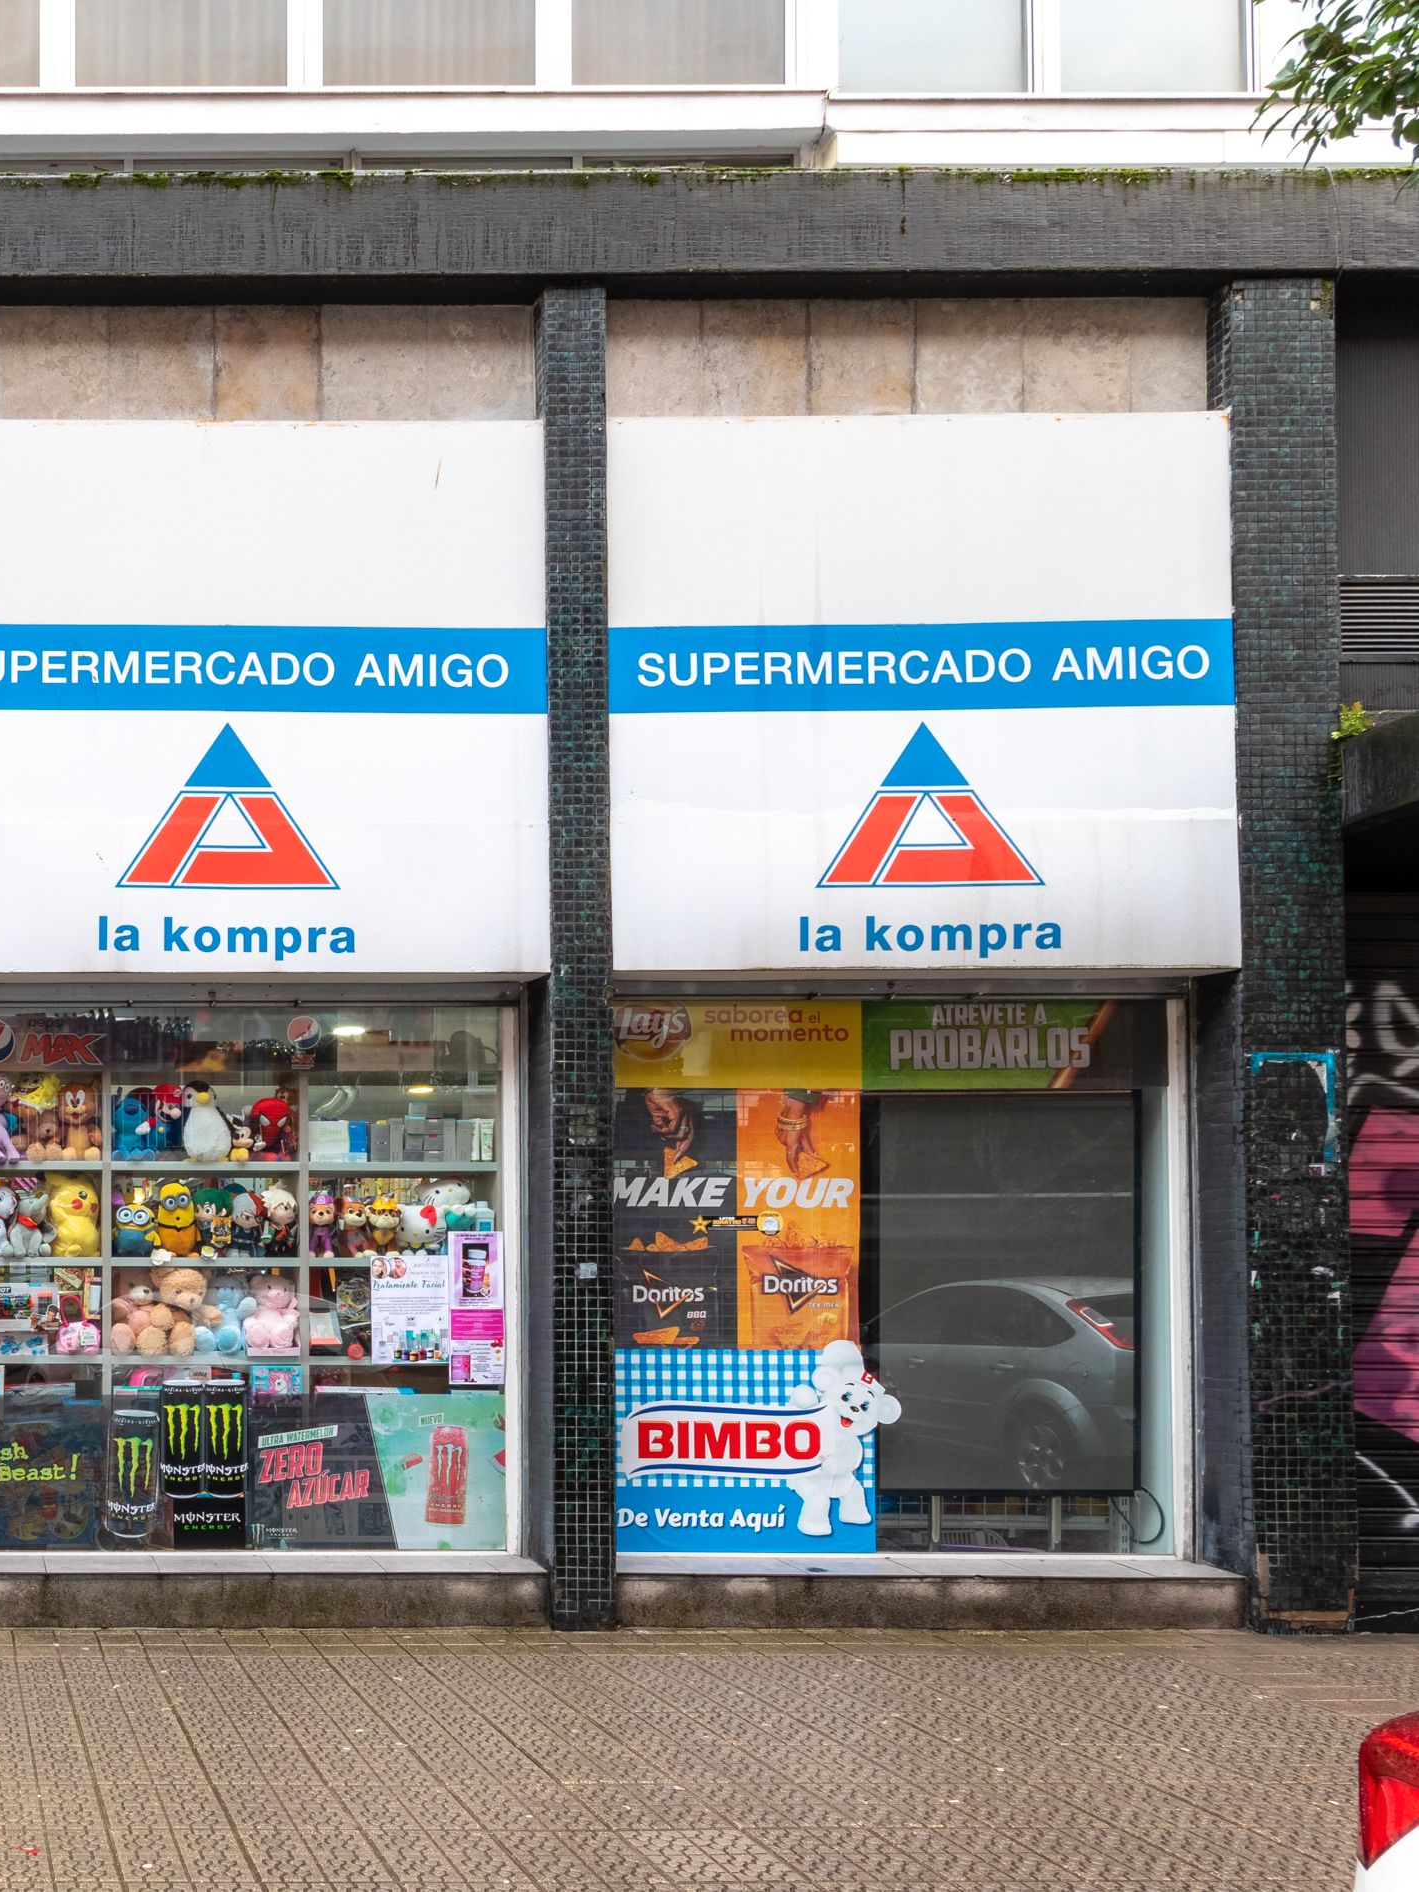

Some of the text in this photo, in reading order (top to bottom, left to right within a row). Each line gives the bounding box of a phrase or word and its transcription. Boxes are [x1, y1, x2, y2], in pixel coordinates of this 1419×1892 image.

[354, 652, 509, 688] AMIGO
[637, 645, 1210, 687] SUPERMERCADO AMIGO
[98, 915, 356, 961] la kompra
[799, 915, 1063, 960] la kompra
[28, 1018, 65, 1028] pepsi
[704, 1004, 821, 1024] saborea el
[1034, 1002, 1048, 1025] A
[731, 1025, 849, 1042] momento
[19, 1032, 106, 1066] MAX
[889, 1027, 1090, 1071] PROBARLOS
[614, 1176, 854, 1209] MAKE YOUR
[422, 1280, 445, 1288] Facial
[632, 1284, 705, 1303] Doritos
[764, 1275, 838, 1294] Doritos
[686, 1310, 707, 1319] BBQ
[861, 1370, 875, 1385] B
[262, 1426, 335, 1446] ULTRA WATERMELON
[637, 1420, 822, 1460] BIMBO
[159, 1462, 206, 1475] MONSTER
[258, 1441, 324, 1484] ZERO
[286, 1469, 371, 1510] AZÚCAR
[108, 1500, 157, 1515] MONSTER
[174, 1511, 241, 1523] MONSTER
[617, 1503, 786, 1533] De Venta Aquí
